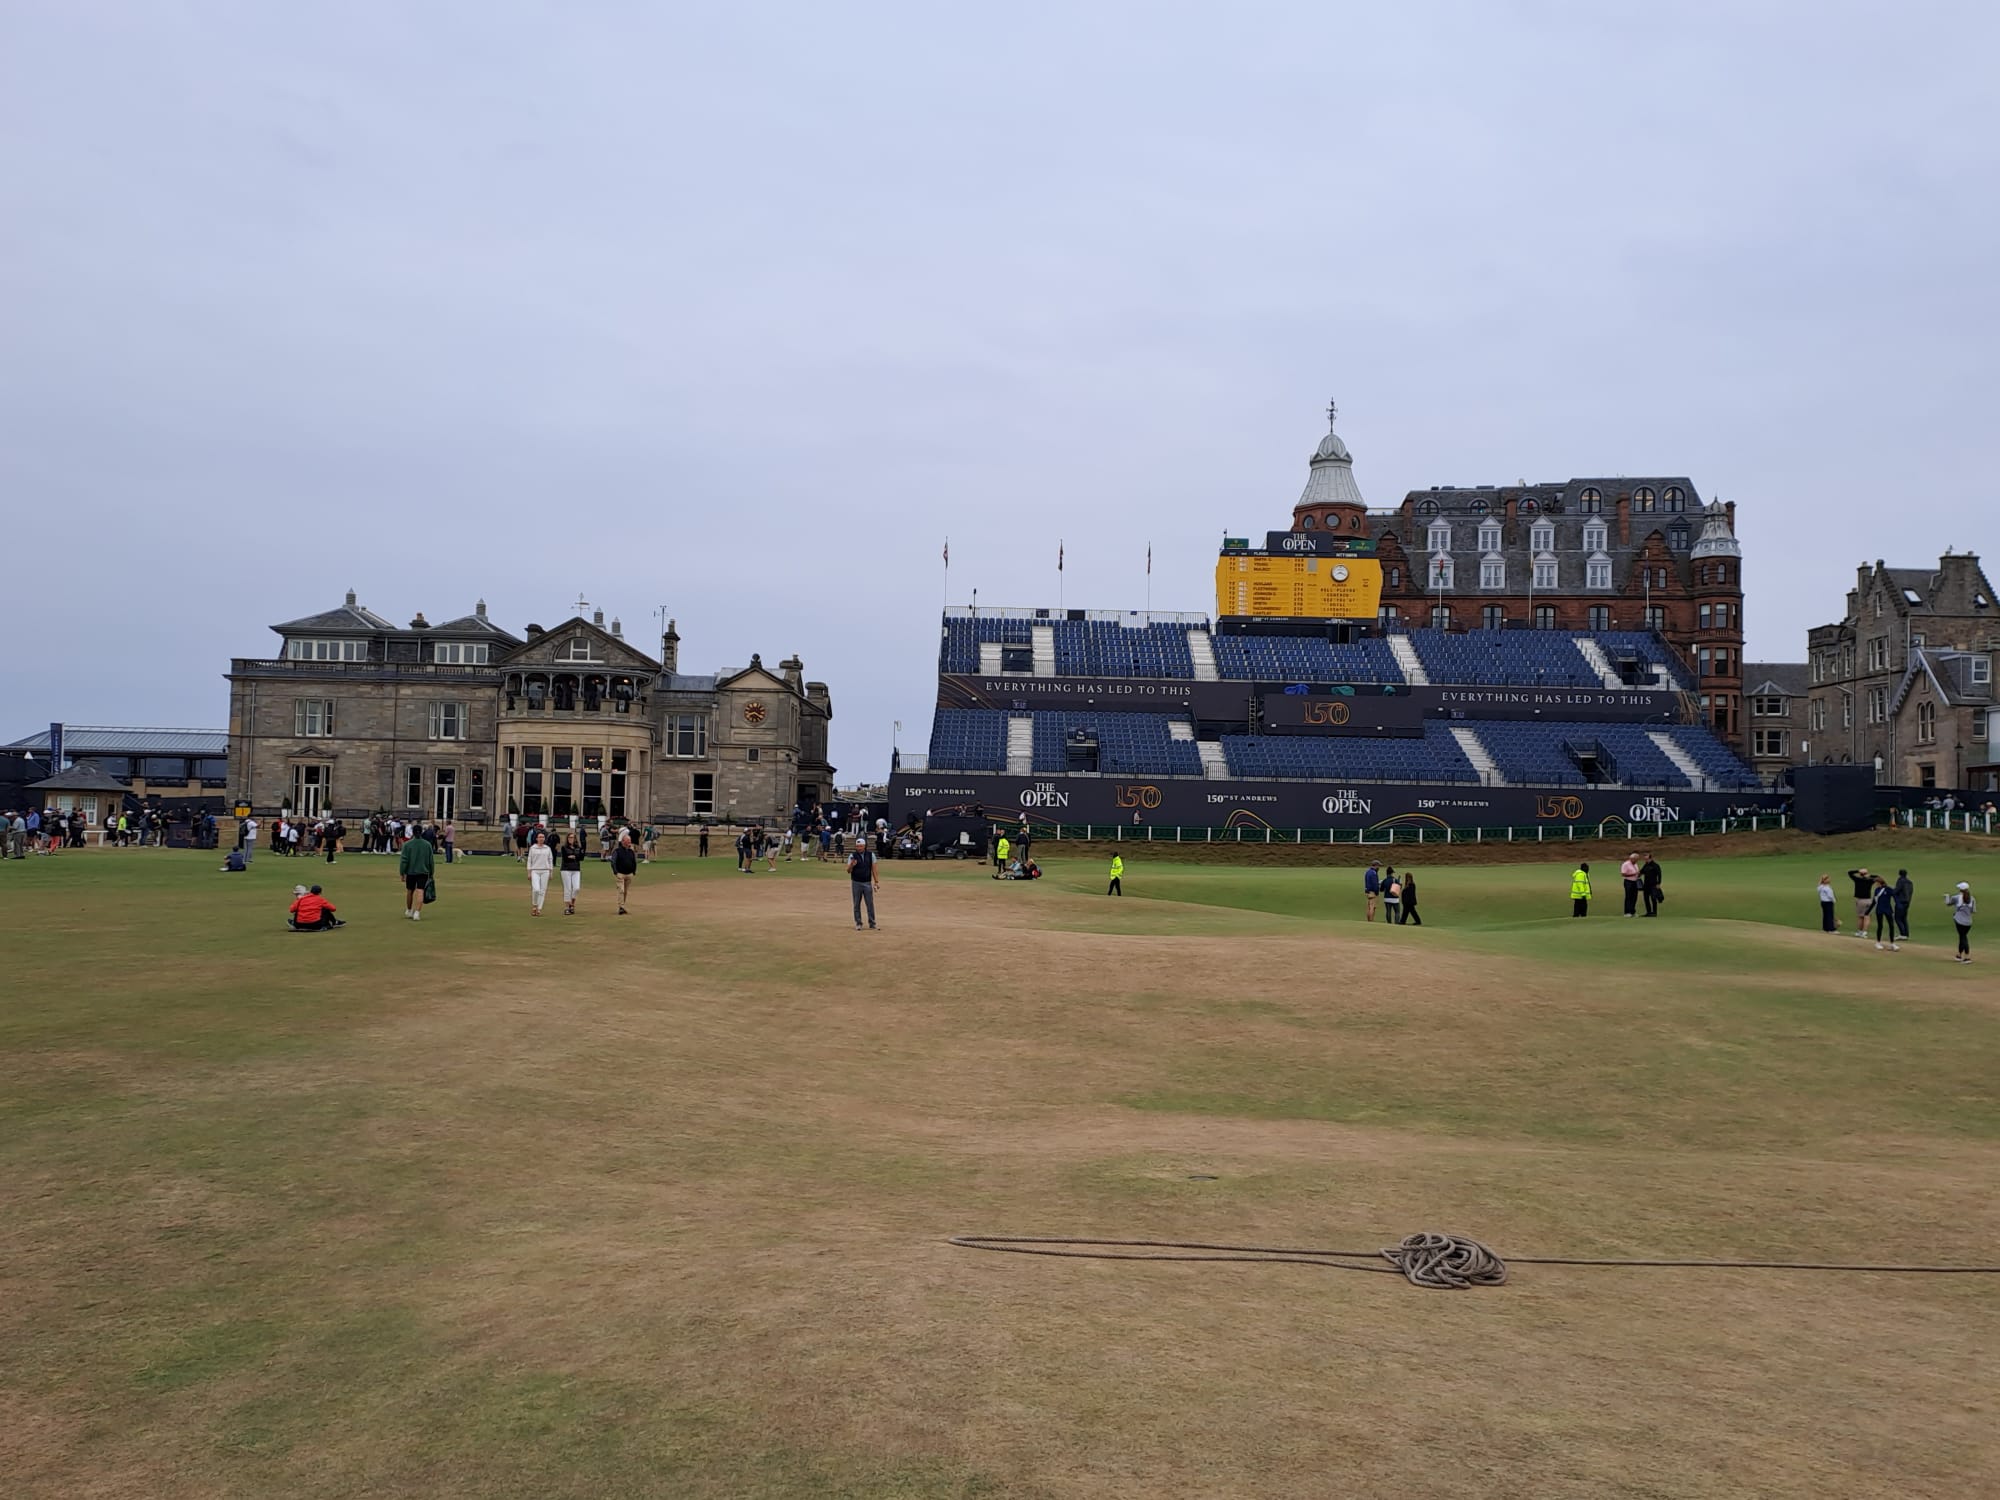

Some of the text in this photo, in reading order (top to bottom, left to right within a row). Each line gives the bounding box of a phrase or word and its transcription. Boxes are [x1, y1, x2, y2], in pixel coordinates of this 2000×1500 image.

[1282, 538, 1316, 550] OPEN
[1293, 533, 1307, 541] THE
[985, 681, 1191, 696] EVERYTHING HAS LED TO THIS
[1442, 692, 1652, 705] EVERYTHING HAS LED TO THIS
[1302, 701, 1350, 725] 150
[1034, 782, 1056, 792] THE
[1336, 789, 1358, 799] THE
[1020, 789, 1069, 807] OPEN
[1115, 785, 1162, 809] 150
[1644, 797, 1666, 807] THE
[1322, 796, 1372, 814] OPEN
[1536, 795, 1584, 819] 150
[1629, 804, 1680, 822] OPEN
